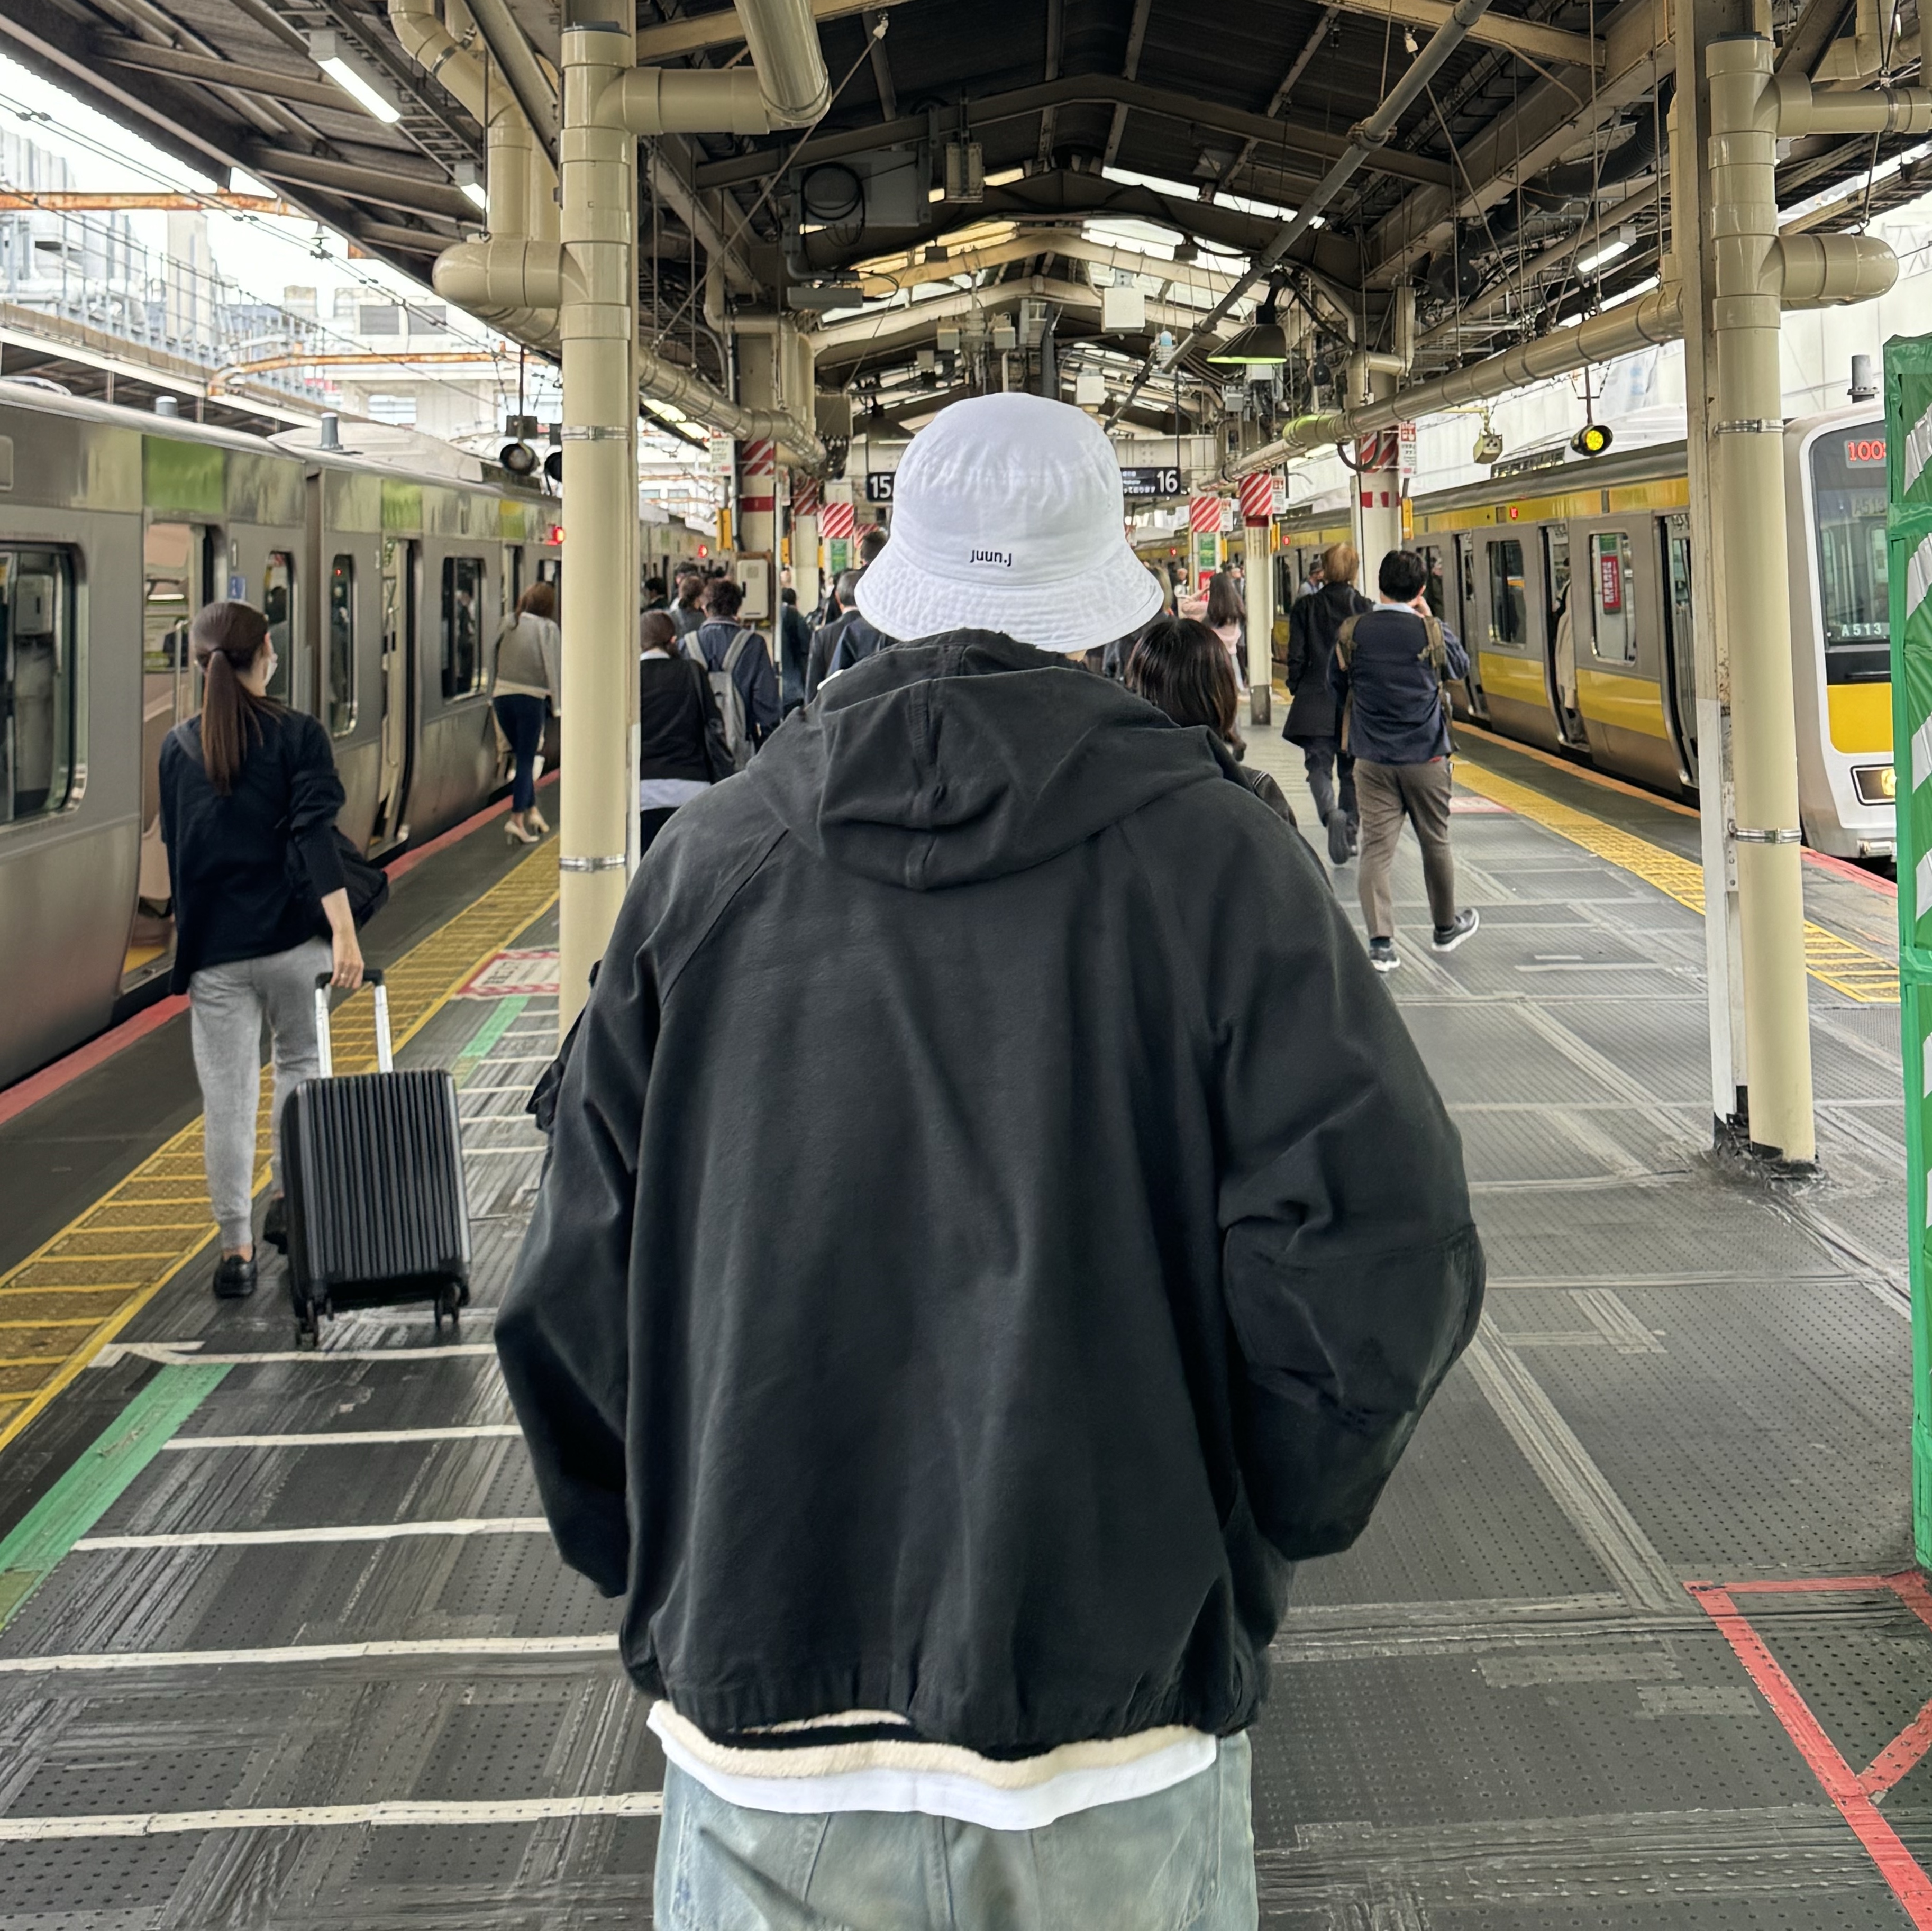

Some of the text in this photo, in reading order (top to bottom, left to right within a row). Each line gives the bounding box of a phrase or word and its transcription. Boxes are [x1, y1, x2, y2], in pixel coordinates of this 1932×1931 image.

[1848, 440, 1887, 461] 100
[870, 475, 891, 498] 15
[1156, 470, 1178, 493] 16
[1841, 622, 1882, 636] A513
